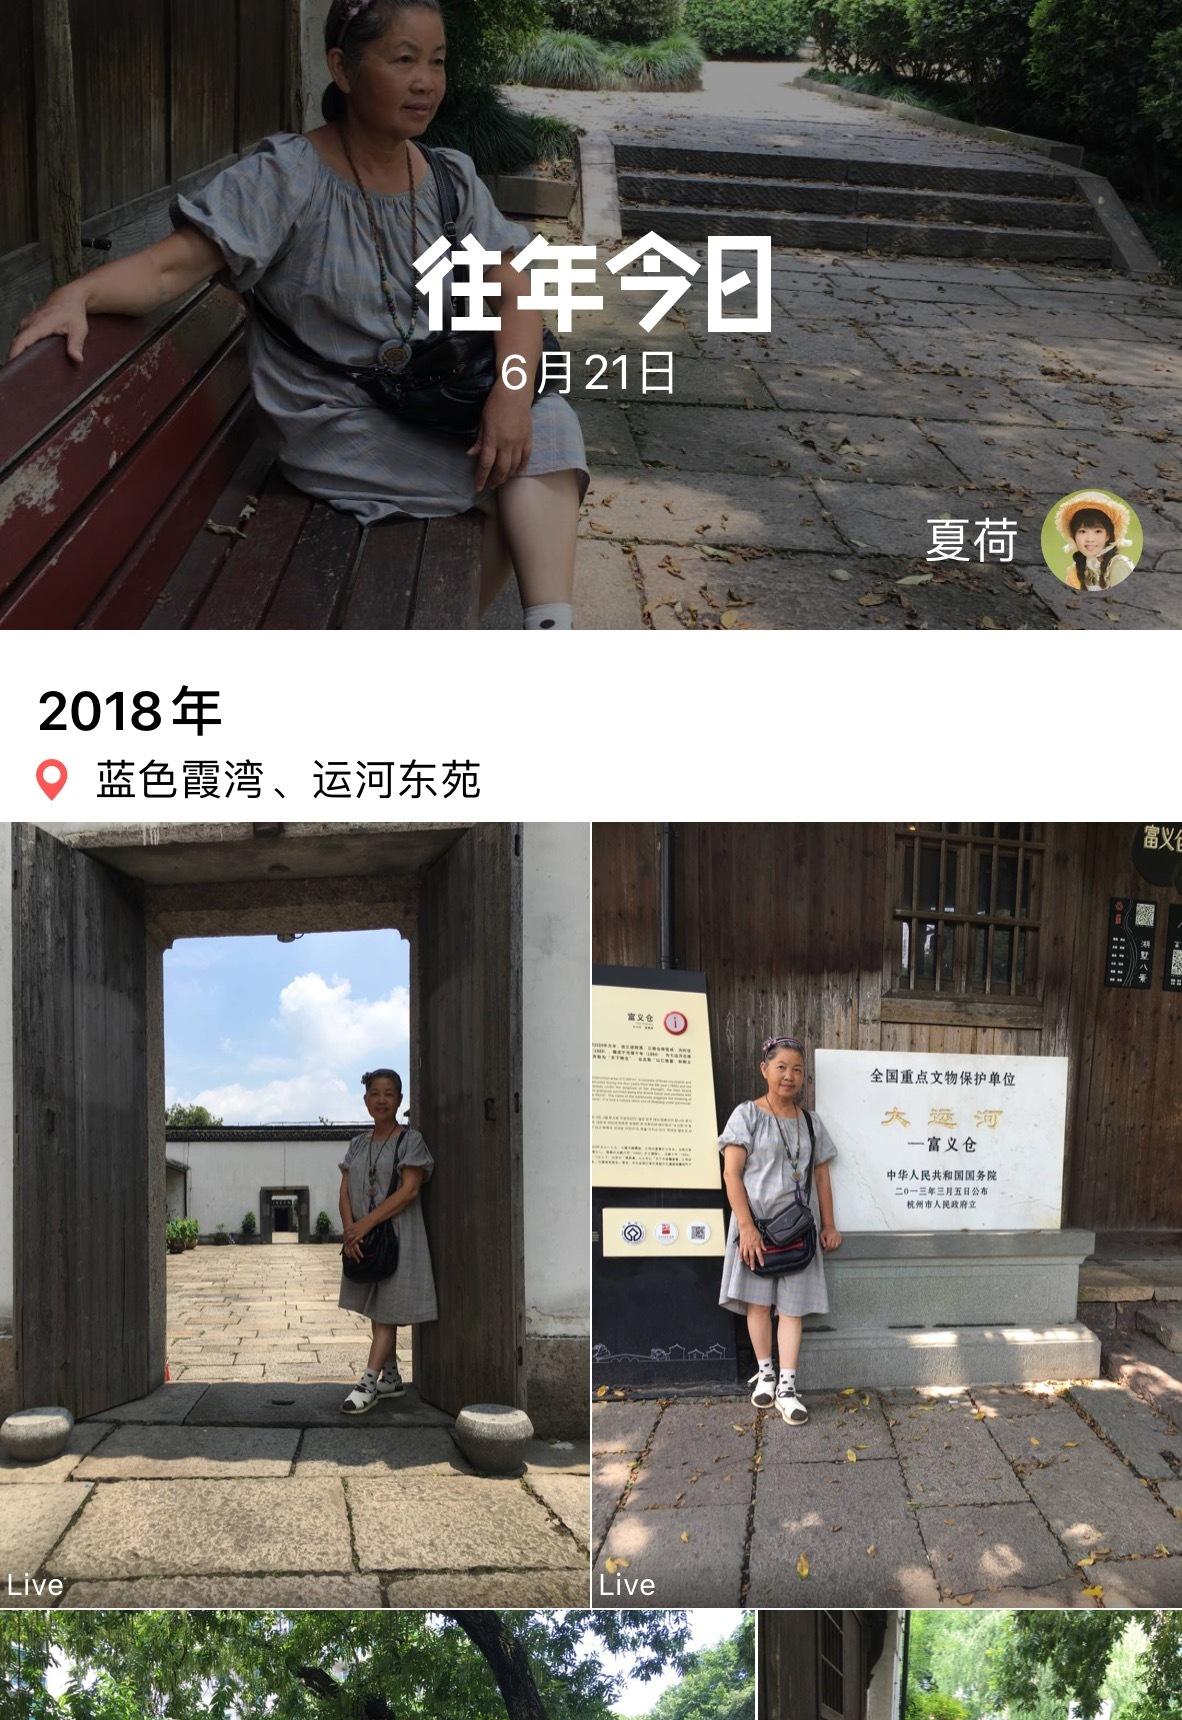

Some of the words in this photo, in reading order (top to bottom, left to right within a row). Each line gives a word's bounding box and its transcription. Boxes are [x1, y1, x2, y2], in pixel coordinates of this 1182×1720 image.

[869, 1067, 1016, 1087] 全国重点文物保护单位
[881, 1106, 1003, 1129] 大运河
[886, 1169, 998, 1182] 中华人民共和国国务院
[906, 1200, 977, 1210] 杭州市人民政府立
